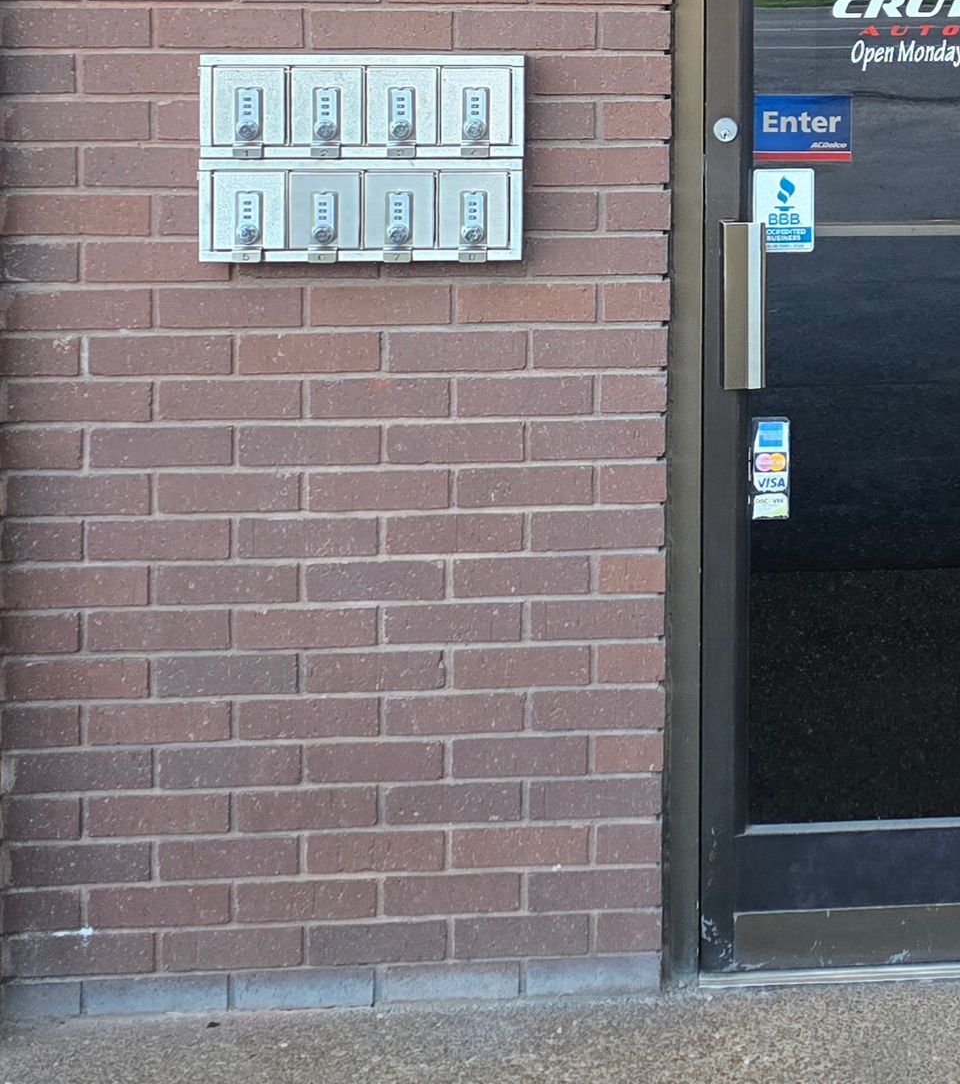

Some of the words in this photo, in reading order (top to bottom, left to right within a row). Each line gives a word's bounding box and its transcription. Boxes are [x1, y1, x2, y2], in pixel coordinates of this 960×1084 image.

[858, 24, 960, 37] AUTO
[851, 40, 893, 71] Open
[763, 111, 841, 133] Enter
[768, 213, 800, 226] BBB
[758, 478, 785, 488] VISA
